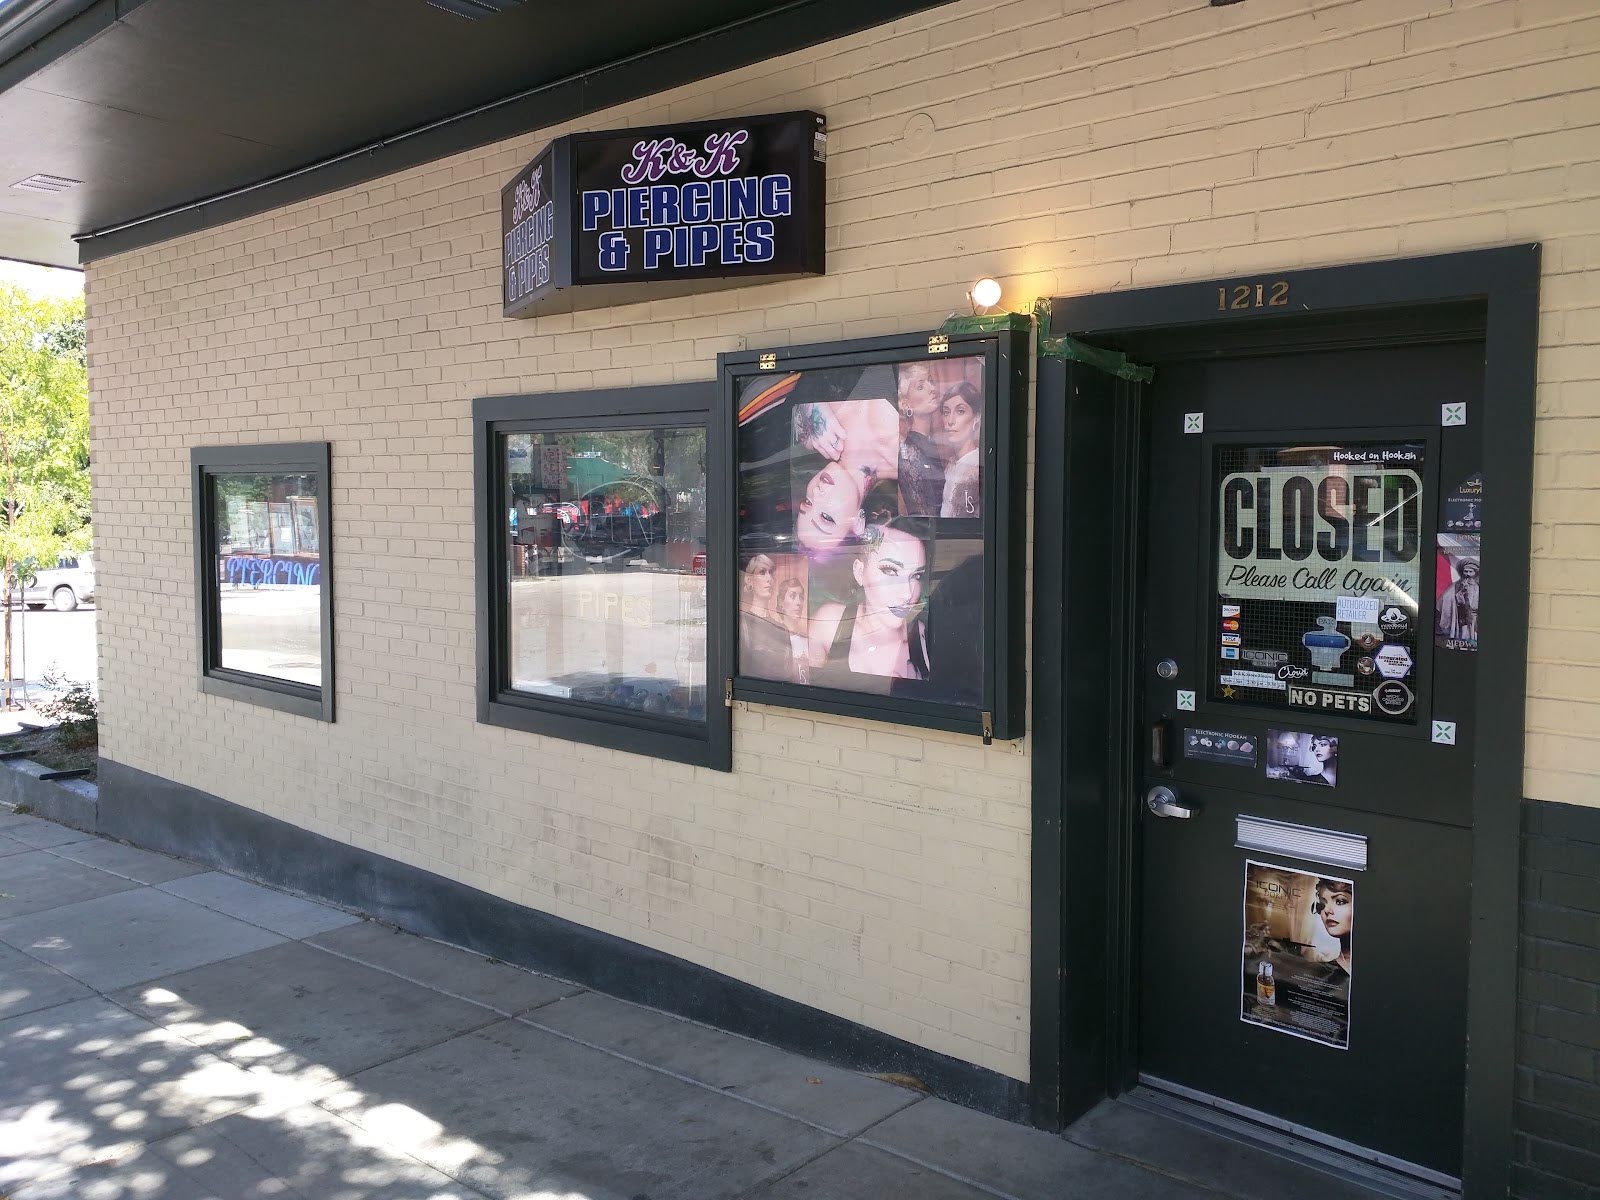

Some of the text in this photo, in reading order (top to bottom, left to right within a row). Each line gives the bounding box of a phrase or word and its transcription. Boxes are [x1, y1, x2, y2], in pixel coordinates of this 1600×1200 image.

[621, 129, 749, 185] K&K
[582, 173, 792, 232] PIERCING
[504, 200, 553, 269] PIERCING
[598, 219, 775, 272] & PIPES
[509, 243, 550, 302] & PIPES
[1217, 281, 1290, 311] 1212
[1333, 451, 1367, 461] Hooked
[1382, 450, 1417, 460] Hookah
[1223, 475, 1419, 564] CLOSED
[1225, 564, 1413, 598] Please Call Again
[580, 591, 651, 628] PIPES
[1337, 599, 1378, 611] AUTHORIZED
[1337, 609, 1367, 621] RETAILER
[1242, 650, 1289, 662] ICONIC
[1291, 689, 1317, 706] NO
[1321, 693, 1371, 713] PETS
[1195, 729, 1224, 738] ELECTRONIC
